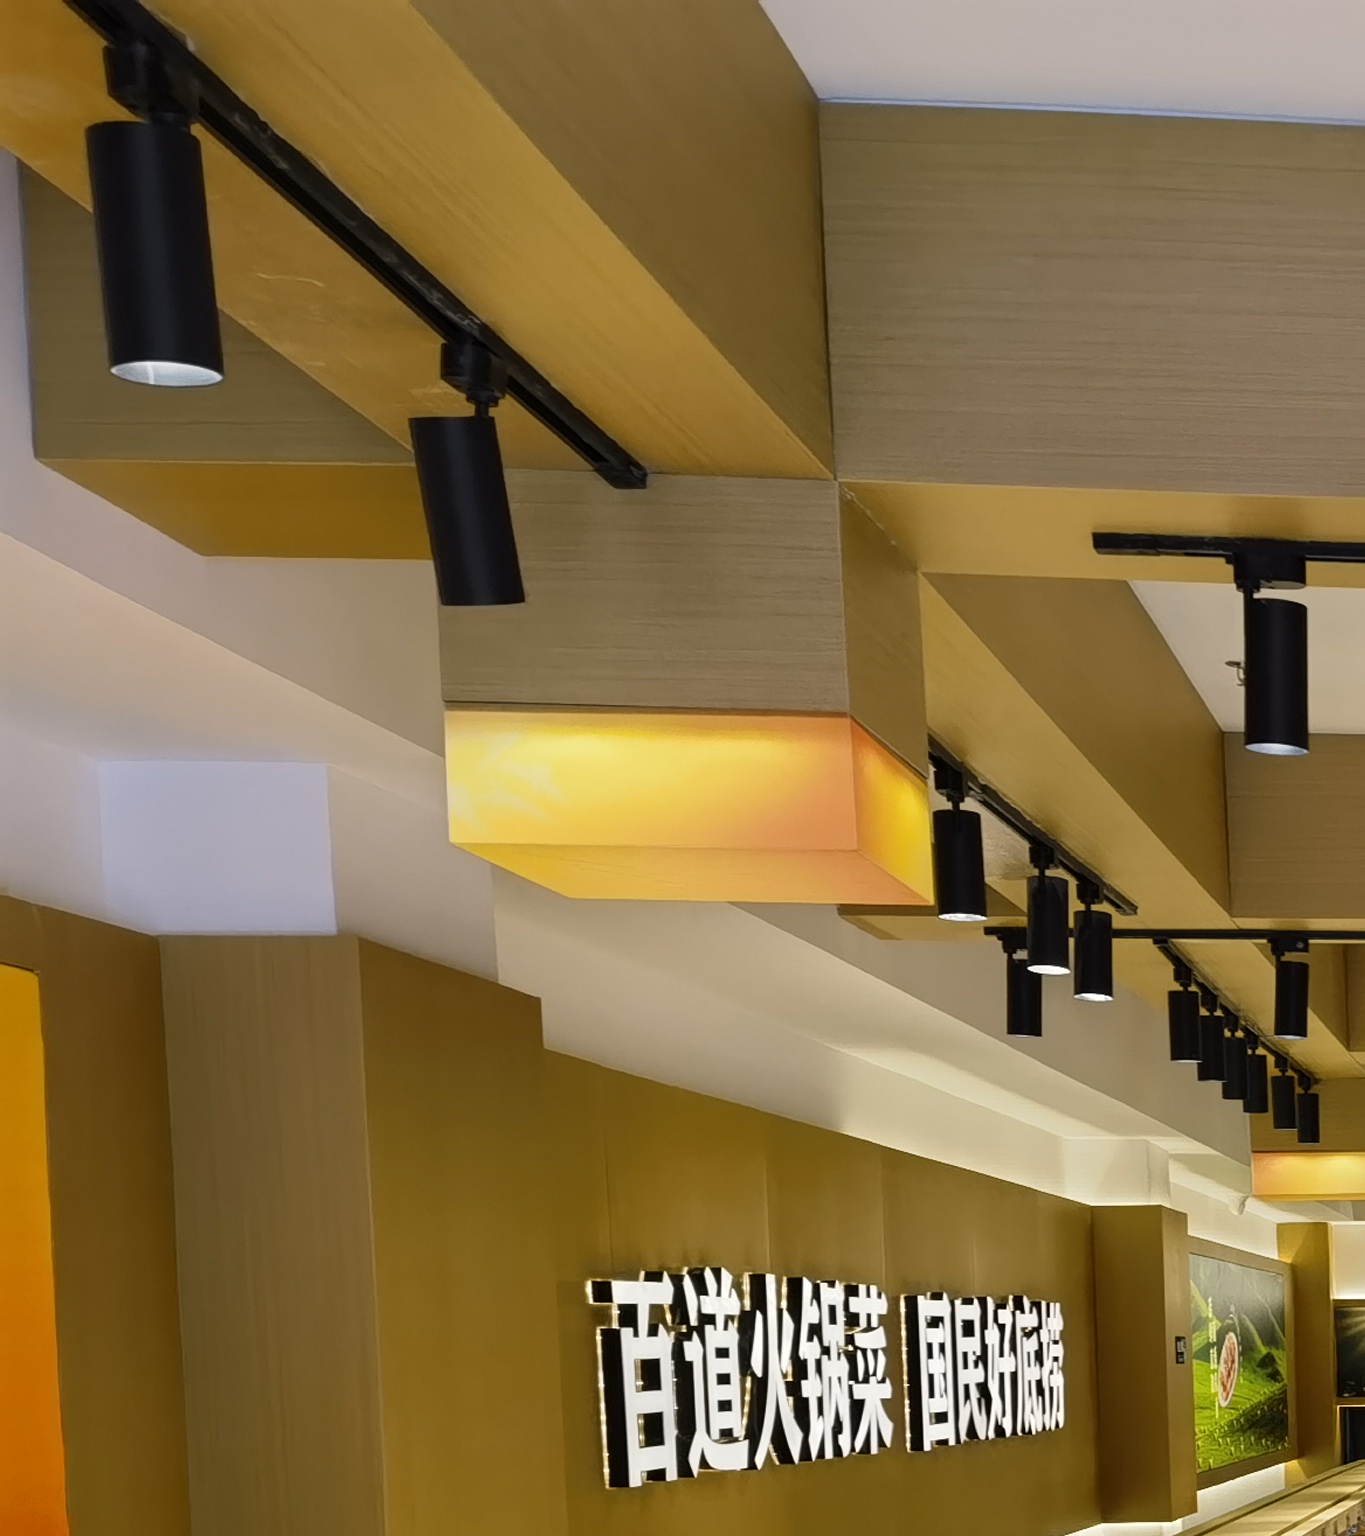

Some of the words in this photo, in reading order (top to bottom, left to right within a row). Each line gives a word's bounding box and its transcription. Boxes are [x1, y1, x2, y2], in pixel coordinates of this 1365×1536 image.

[609, 1267, 894, 1483] 百道火锅菜
[917, 1293, 1065, 1452] 国民好底捞
